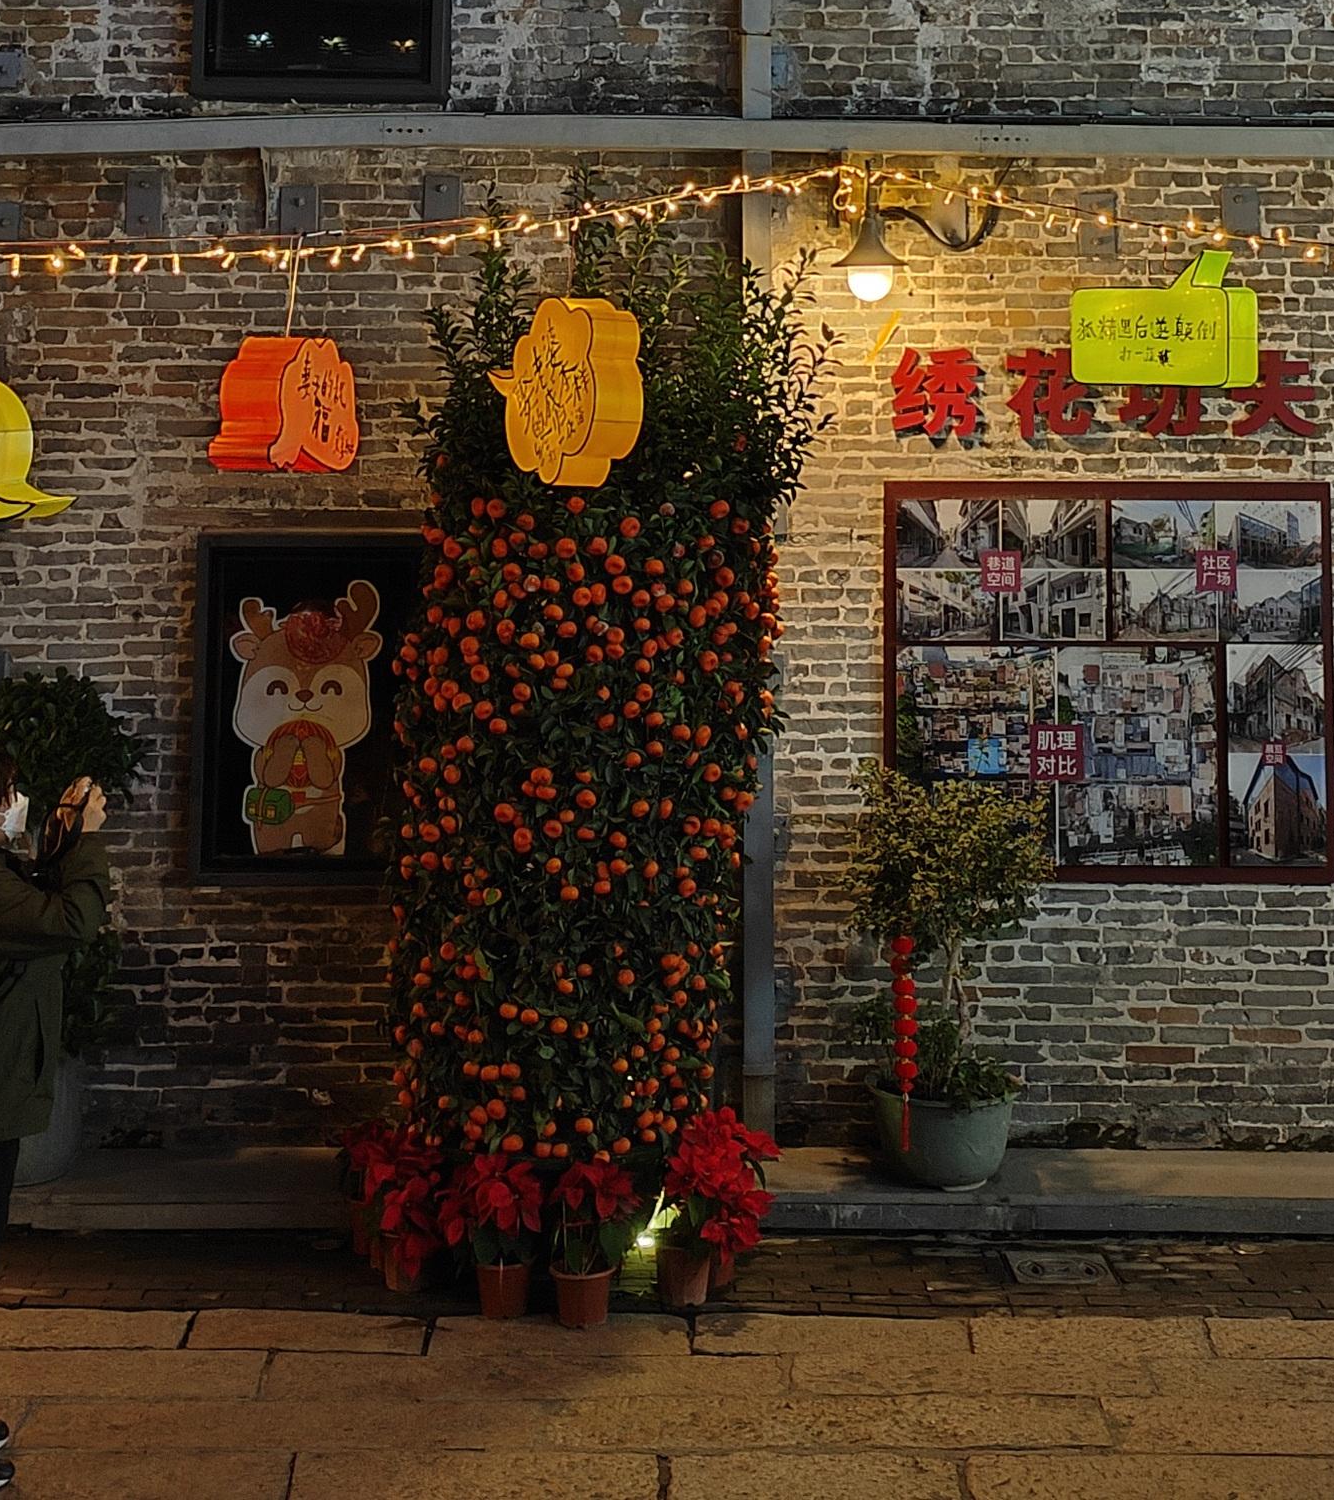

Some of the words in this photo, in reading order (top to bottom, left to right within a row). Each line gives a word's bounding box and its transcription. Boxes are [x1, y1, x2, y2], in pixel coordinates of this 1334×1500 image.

[986, 556, 1015, 571] 巷道
[1202, 555, 1231, 570] 社区
[986, 572, 1015, 587] 空间
[1202, 571, 1231, 586] 广场
[1037, 730, 1077, 751] 肌理
[1037, 754, 1077, 775] 对比
